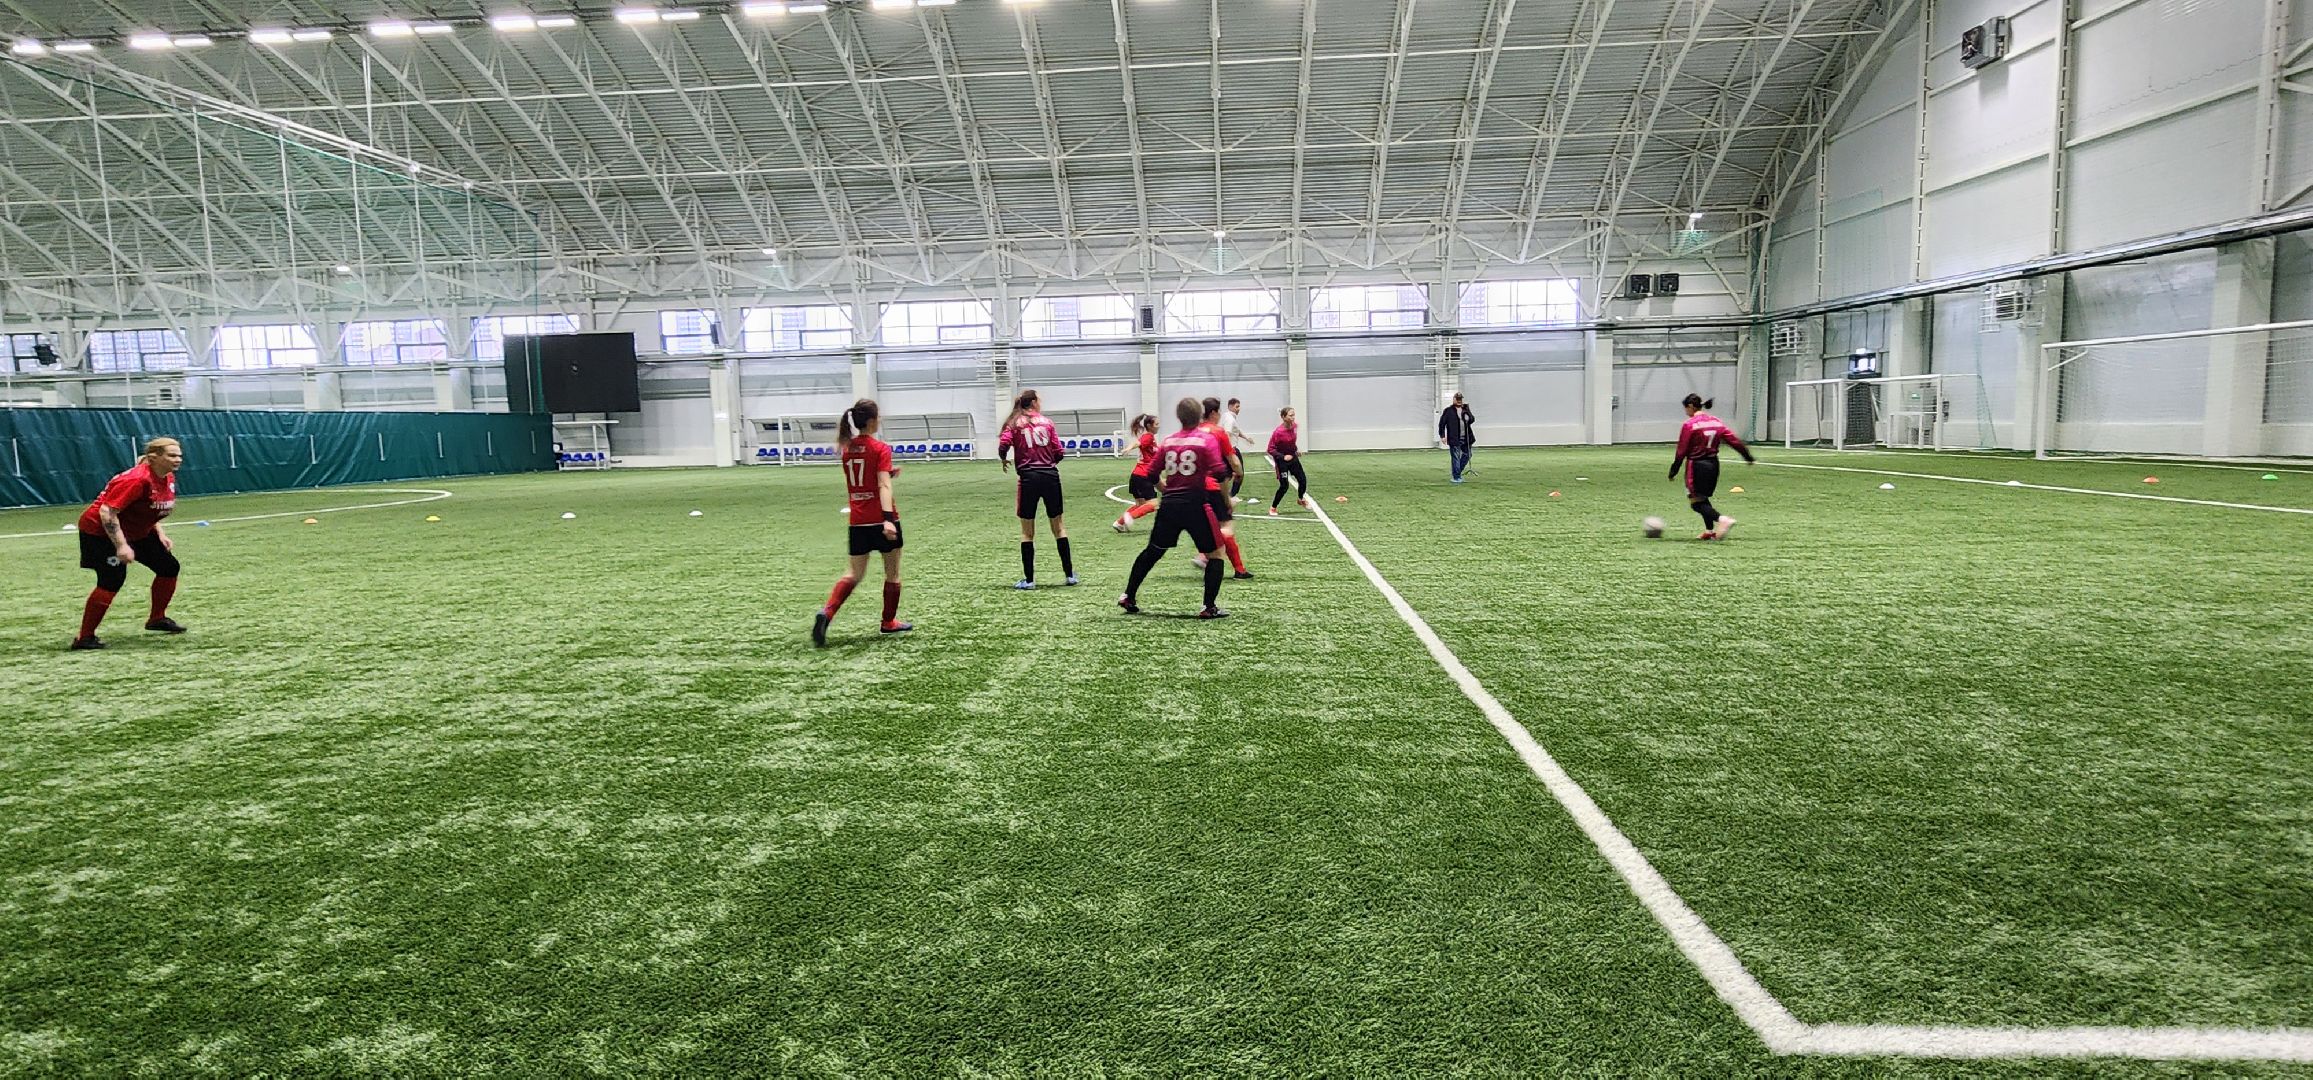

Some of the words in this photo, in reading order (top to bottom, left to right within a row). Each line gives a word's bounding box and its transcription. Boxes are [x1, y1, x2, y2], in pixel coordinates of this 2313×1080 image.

[1021, 426, 1049, 448] 10
[1703, 430, 1717, 448] 7
[846, 459, 865, 487] 17
[1165, 450, 1197, 476] 88
